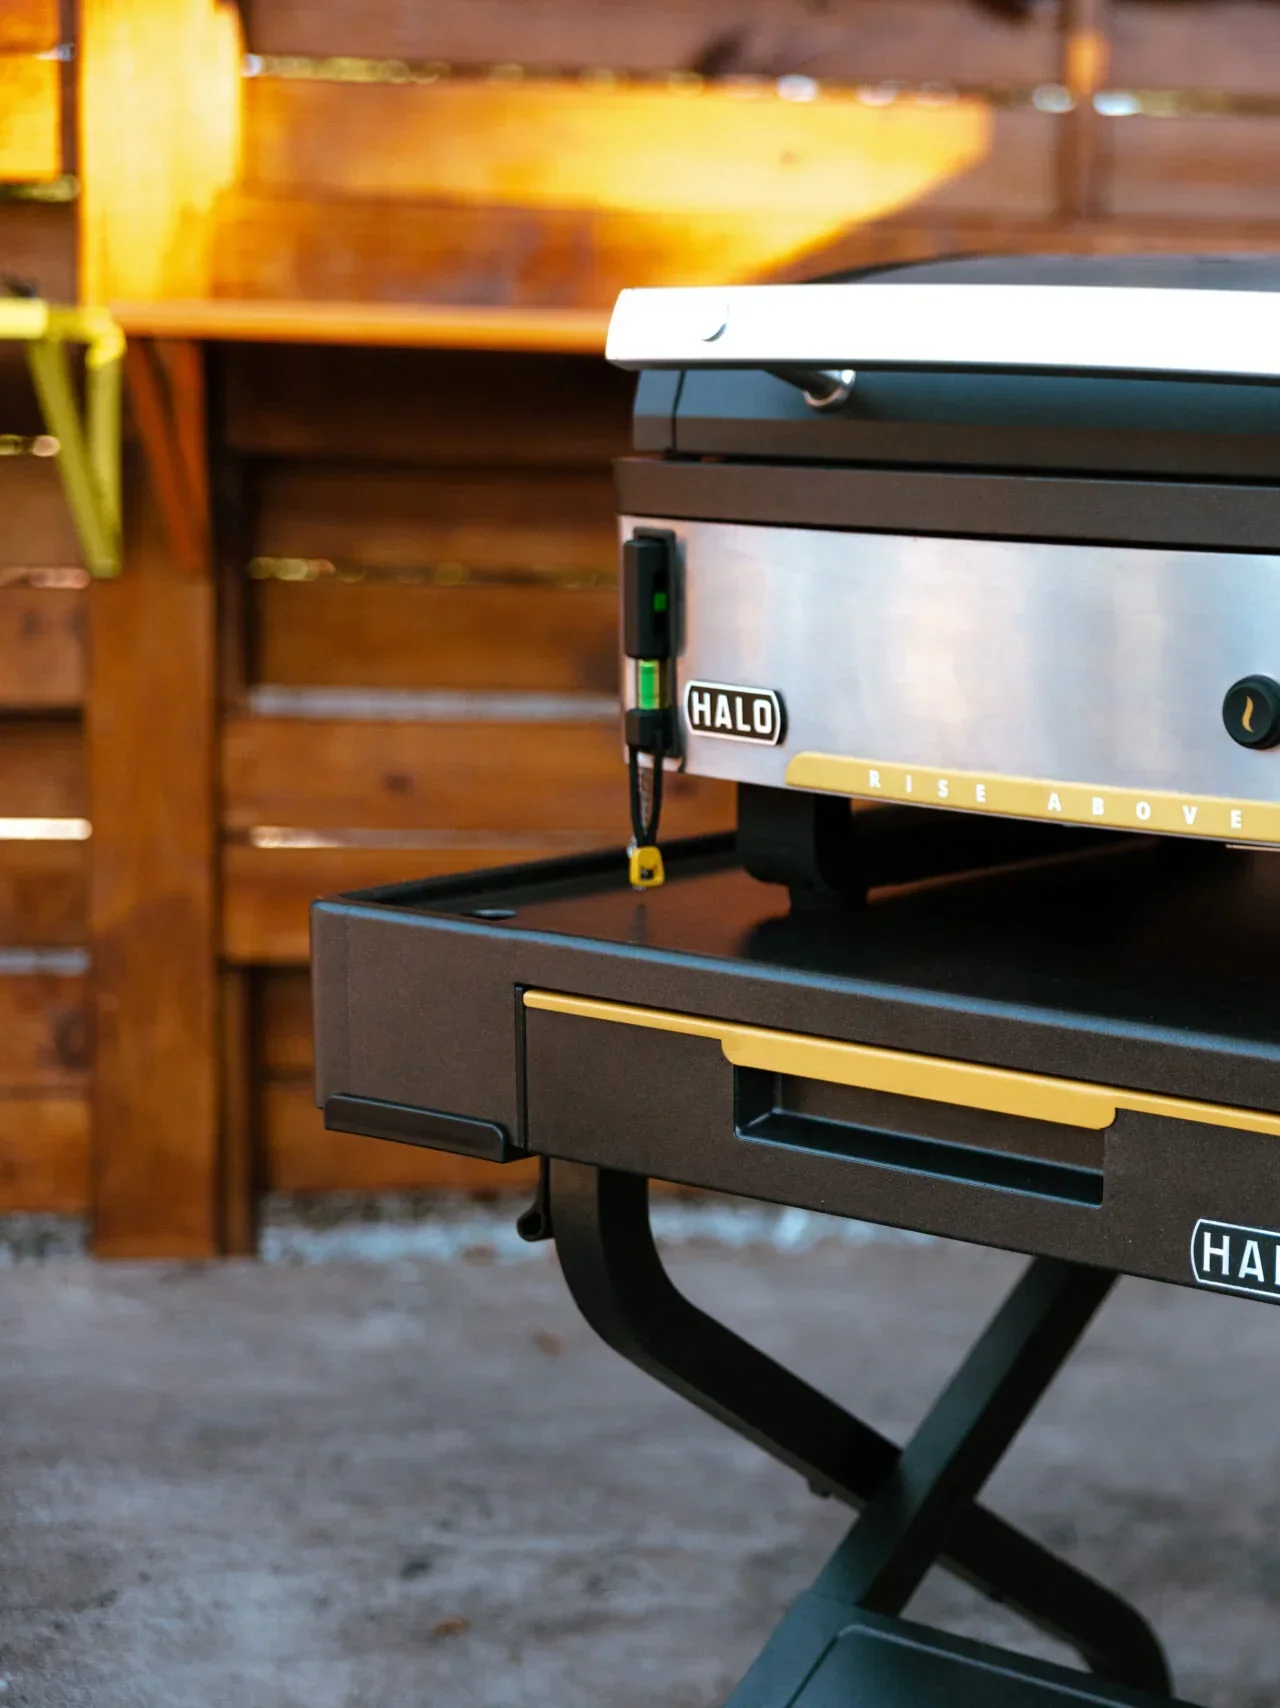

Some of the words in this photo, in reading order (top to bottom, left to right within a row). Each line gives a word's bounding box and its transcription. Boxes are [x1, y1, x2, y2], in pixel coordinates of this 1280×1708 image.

[691, 691, 772, 734] HALO
[868, 769, 987, 803] RISE
[1047, 792, 1242, 829] ABOVE
